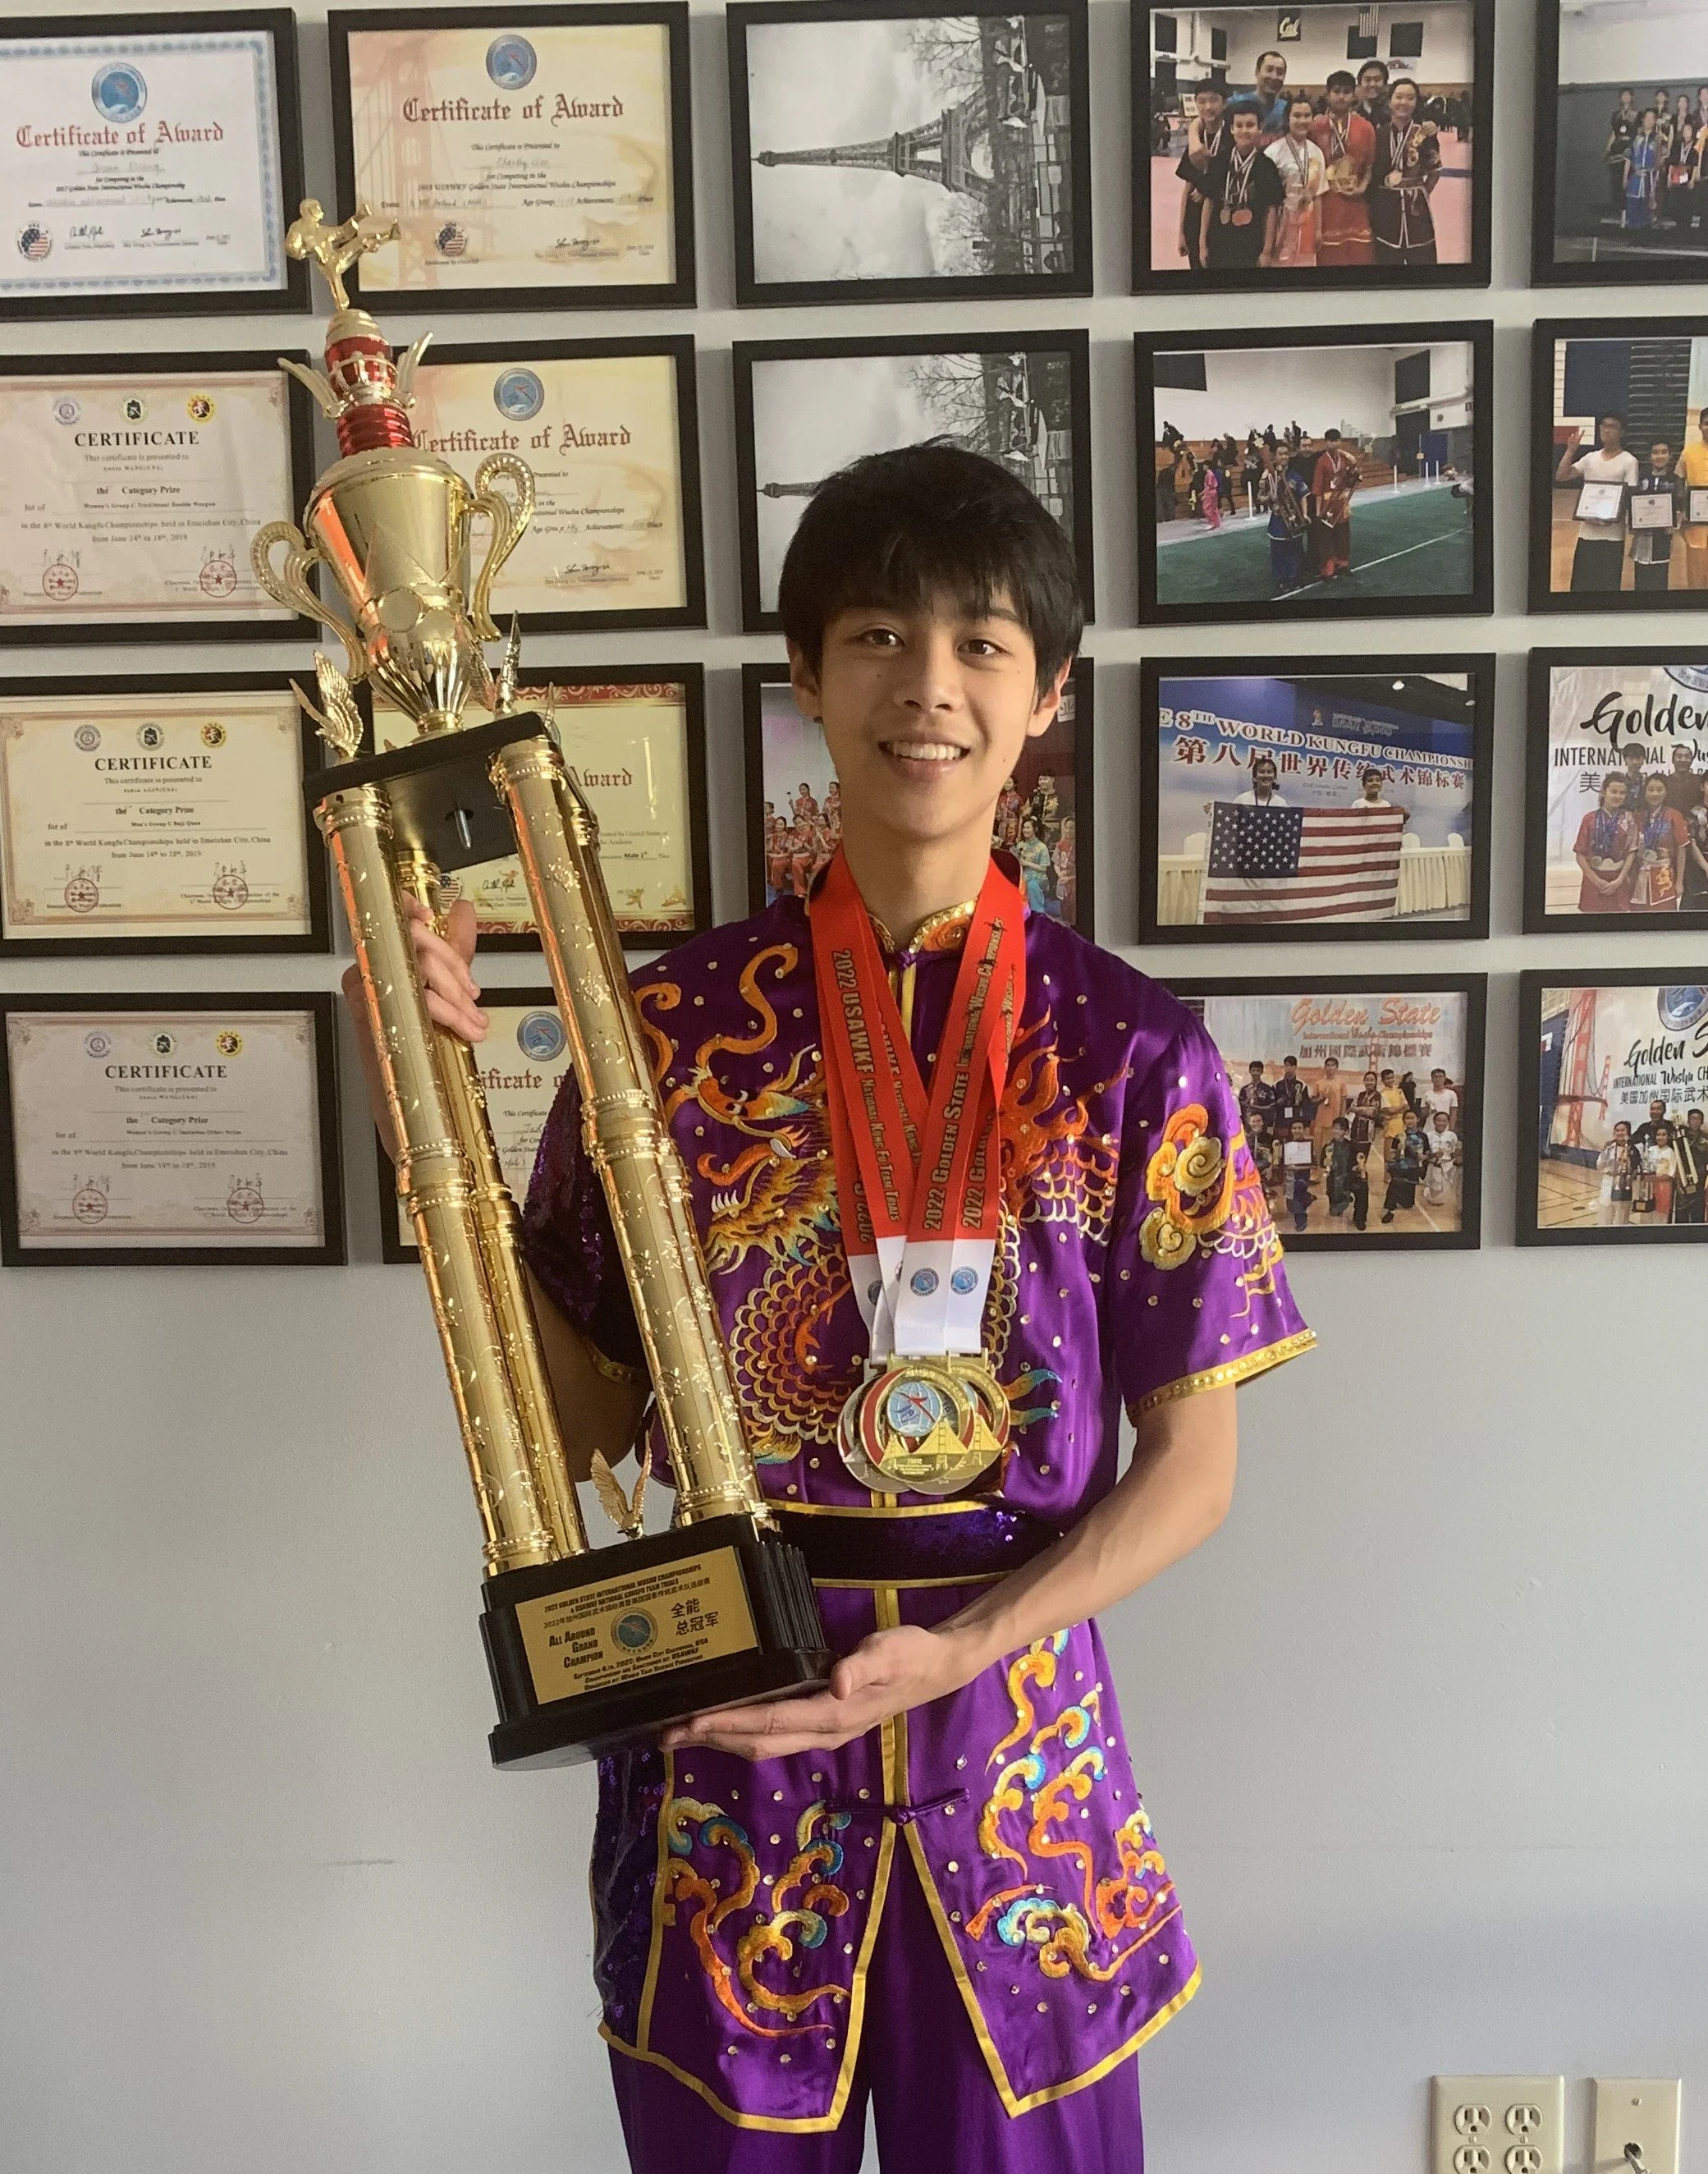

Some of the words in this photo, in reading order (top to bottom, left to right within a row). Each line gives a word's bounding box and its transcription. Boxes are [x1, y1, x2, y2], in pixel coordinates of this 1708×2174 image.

[1279, 16, 1300, 38] Cal
[403, 96, 511, 122] Certificate
[522, 94, 544, 119] of
[551, 93, 624, 127] Award
[16, 125, 119, 148] Certificate
[126, 123, 145, 144] of
[153, 121, 223, 149] Award
[485, 143, 516, 152] Certificate
[74, 431, 200, 447] CERTIFICATE
[410, 428, 520, 452] Certificate
[530, 425, 553, 448] of
[559, 423, 631, 456] Award
[97, 486, 108, 495] the
[121, 486, 158, 496] Category
[160, 486, 181, 494] Prize
[1178, 711, 1213, 727] 8TH
[1218, 719, 1303, 745] WORLD
[1309, 736, 1381, 757] KUNGFU
[95, 756, 213, 771] CERTIFICATE
[1555, 745, 1665, 767] INTERNATNAL
[140, 807, 172, 815] Category
[832, 949, 857, 988] 2022
[1291, 998, 1369, 1035] Golden
[1377, 997, 1441, 1025] State
[841, 993, 875, 1074] USAWKF
[1623, 1035, 1685, 1078] Golden
[105, 1065, 227, 1079] CERTIFICATE
[1613, 1072, 1657, 1089] INTERNATIONAL
[1660, 1066, 1693, 1085] Wushu
[944, 1072, 970, 1119] STATE
[151, 1117, 186, 1126] Category
[932, 1124, 959, 1183] GOLDEN
[923, 1188, 946, 1230] 2022
[962, 1187, 985, 1229] 2022
[671, 1598, 701, 1620] 全能
[675, 1611, 719, 1636] 总冠军
[572, 1639, 598, 1653] GRAND
[564, 1651, 604, 1668] CHAMPION
